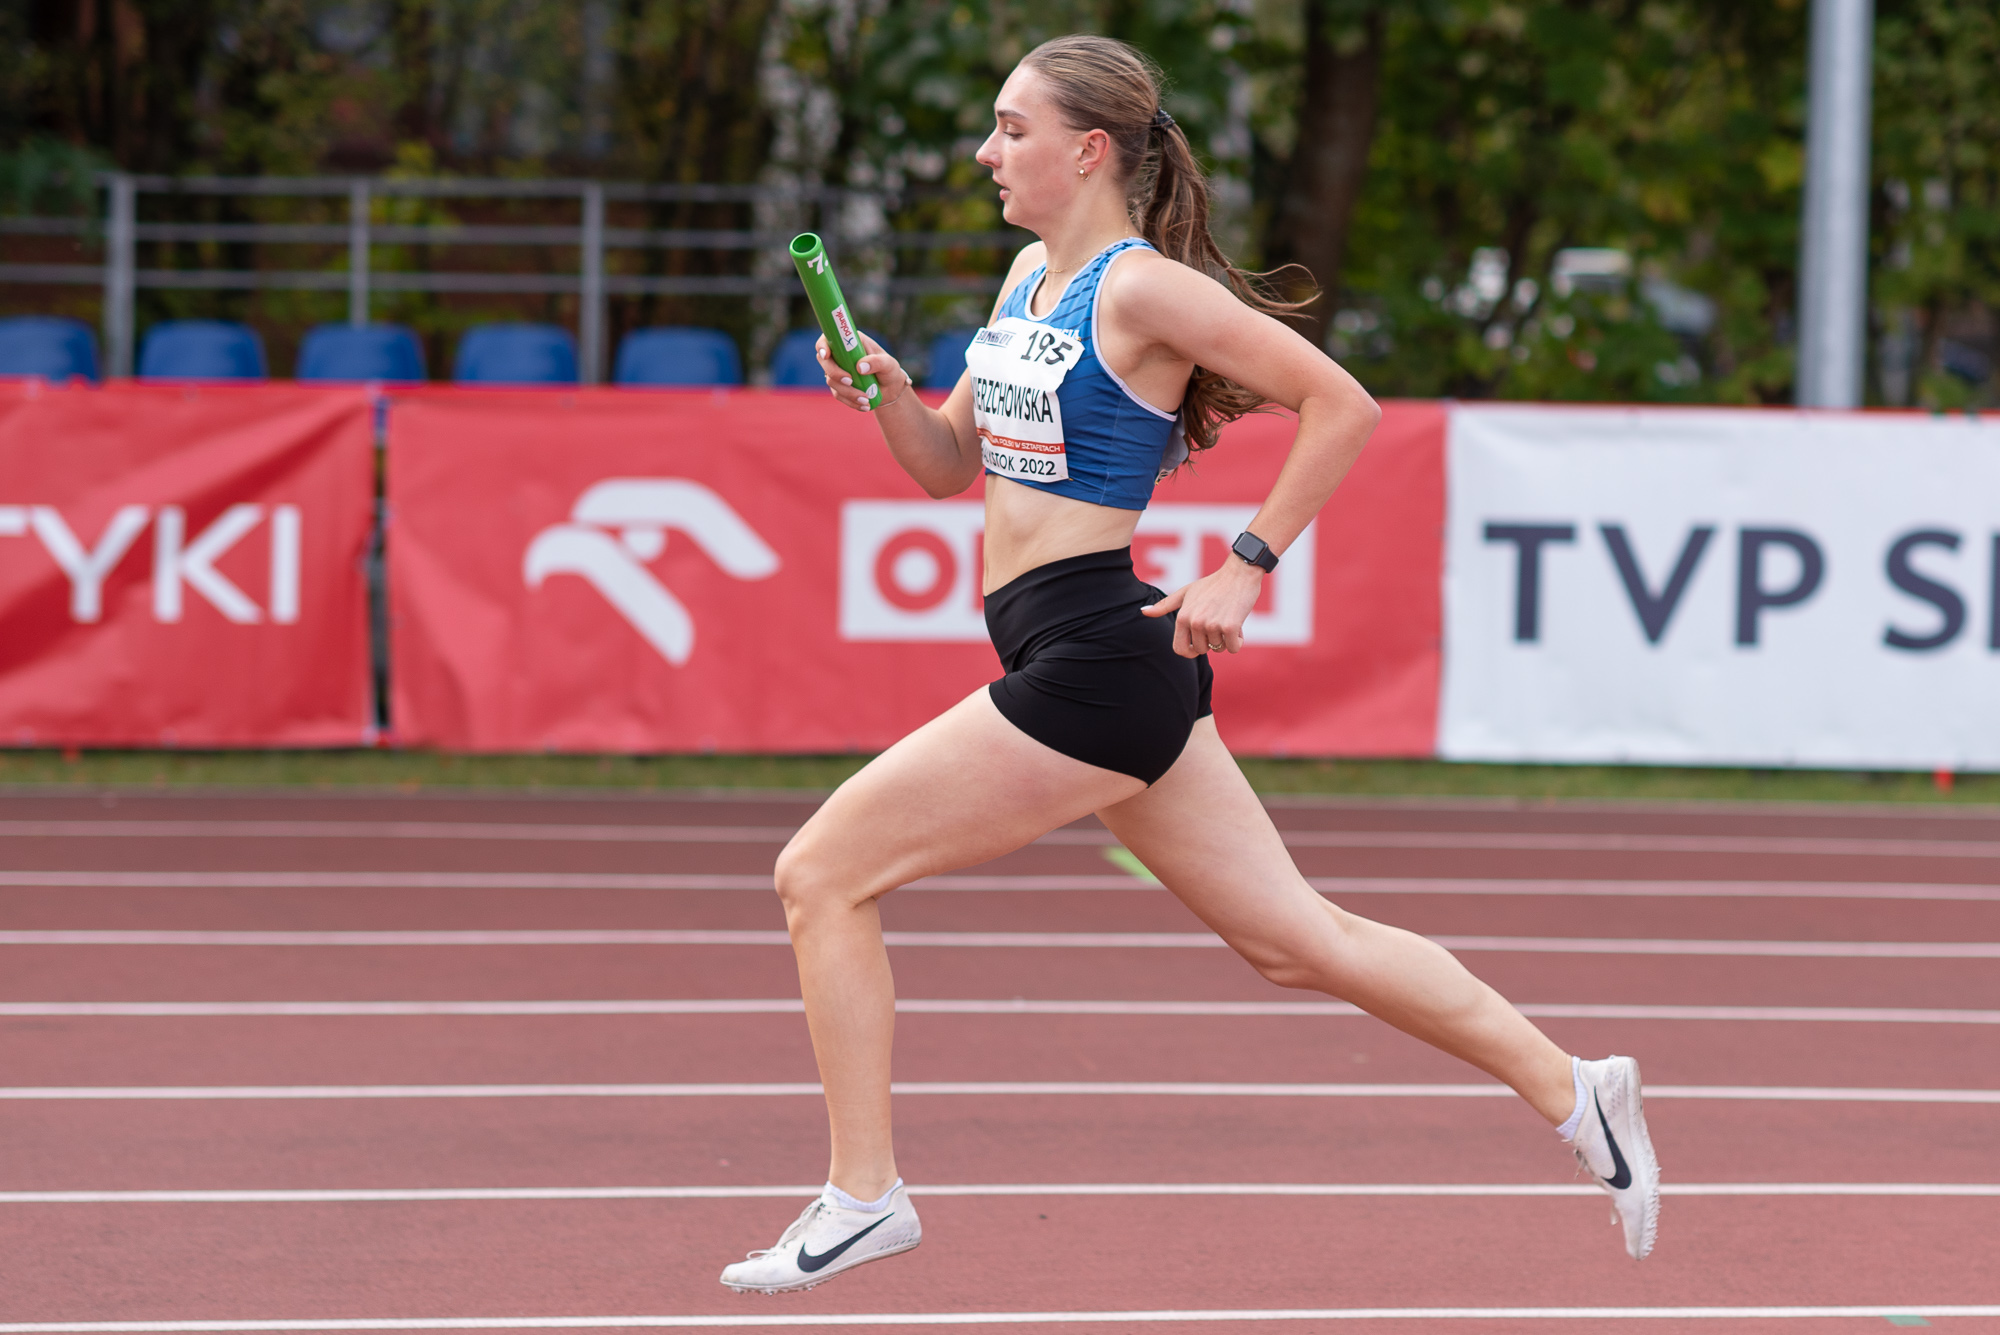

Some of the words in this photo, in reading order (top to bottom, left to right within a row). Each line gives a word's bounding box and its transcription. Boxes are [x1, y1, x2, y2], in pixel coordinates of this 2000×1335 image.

[835, 311, 852, 337] polanik
[1020, 330, 1073, 365] 195
[1021, 442, 1061, 452] SZTAFETACH
[1019, 457, 1057, 476] 2022
[1483, 522, 1825, 648] TVP
[1882, 530, 2000, 653] S
